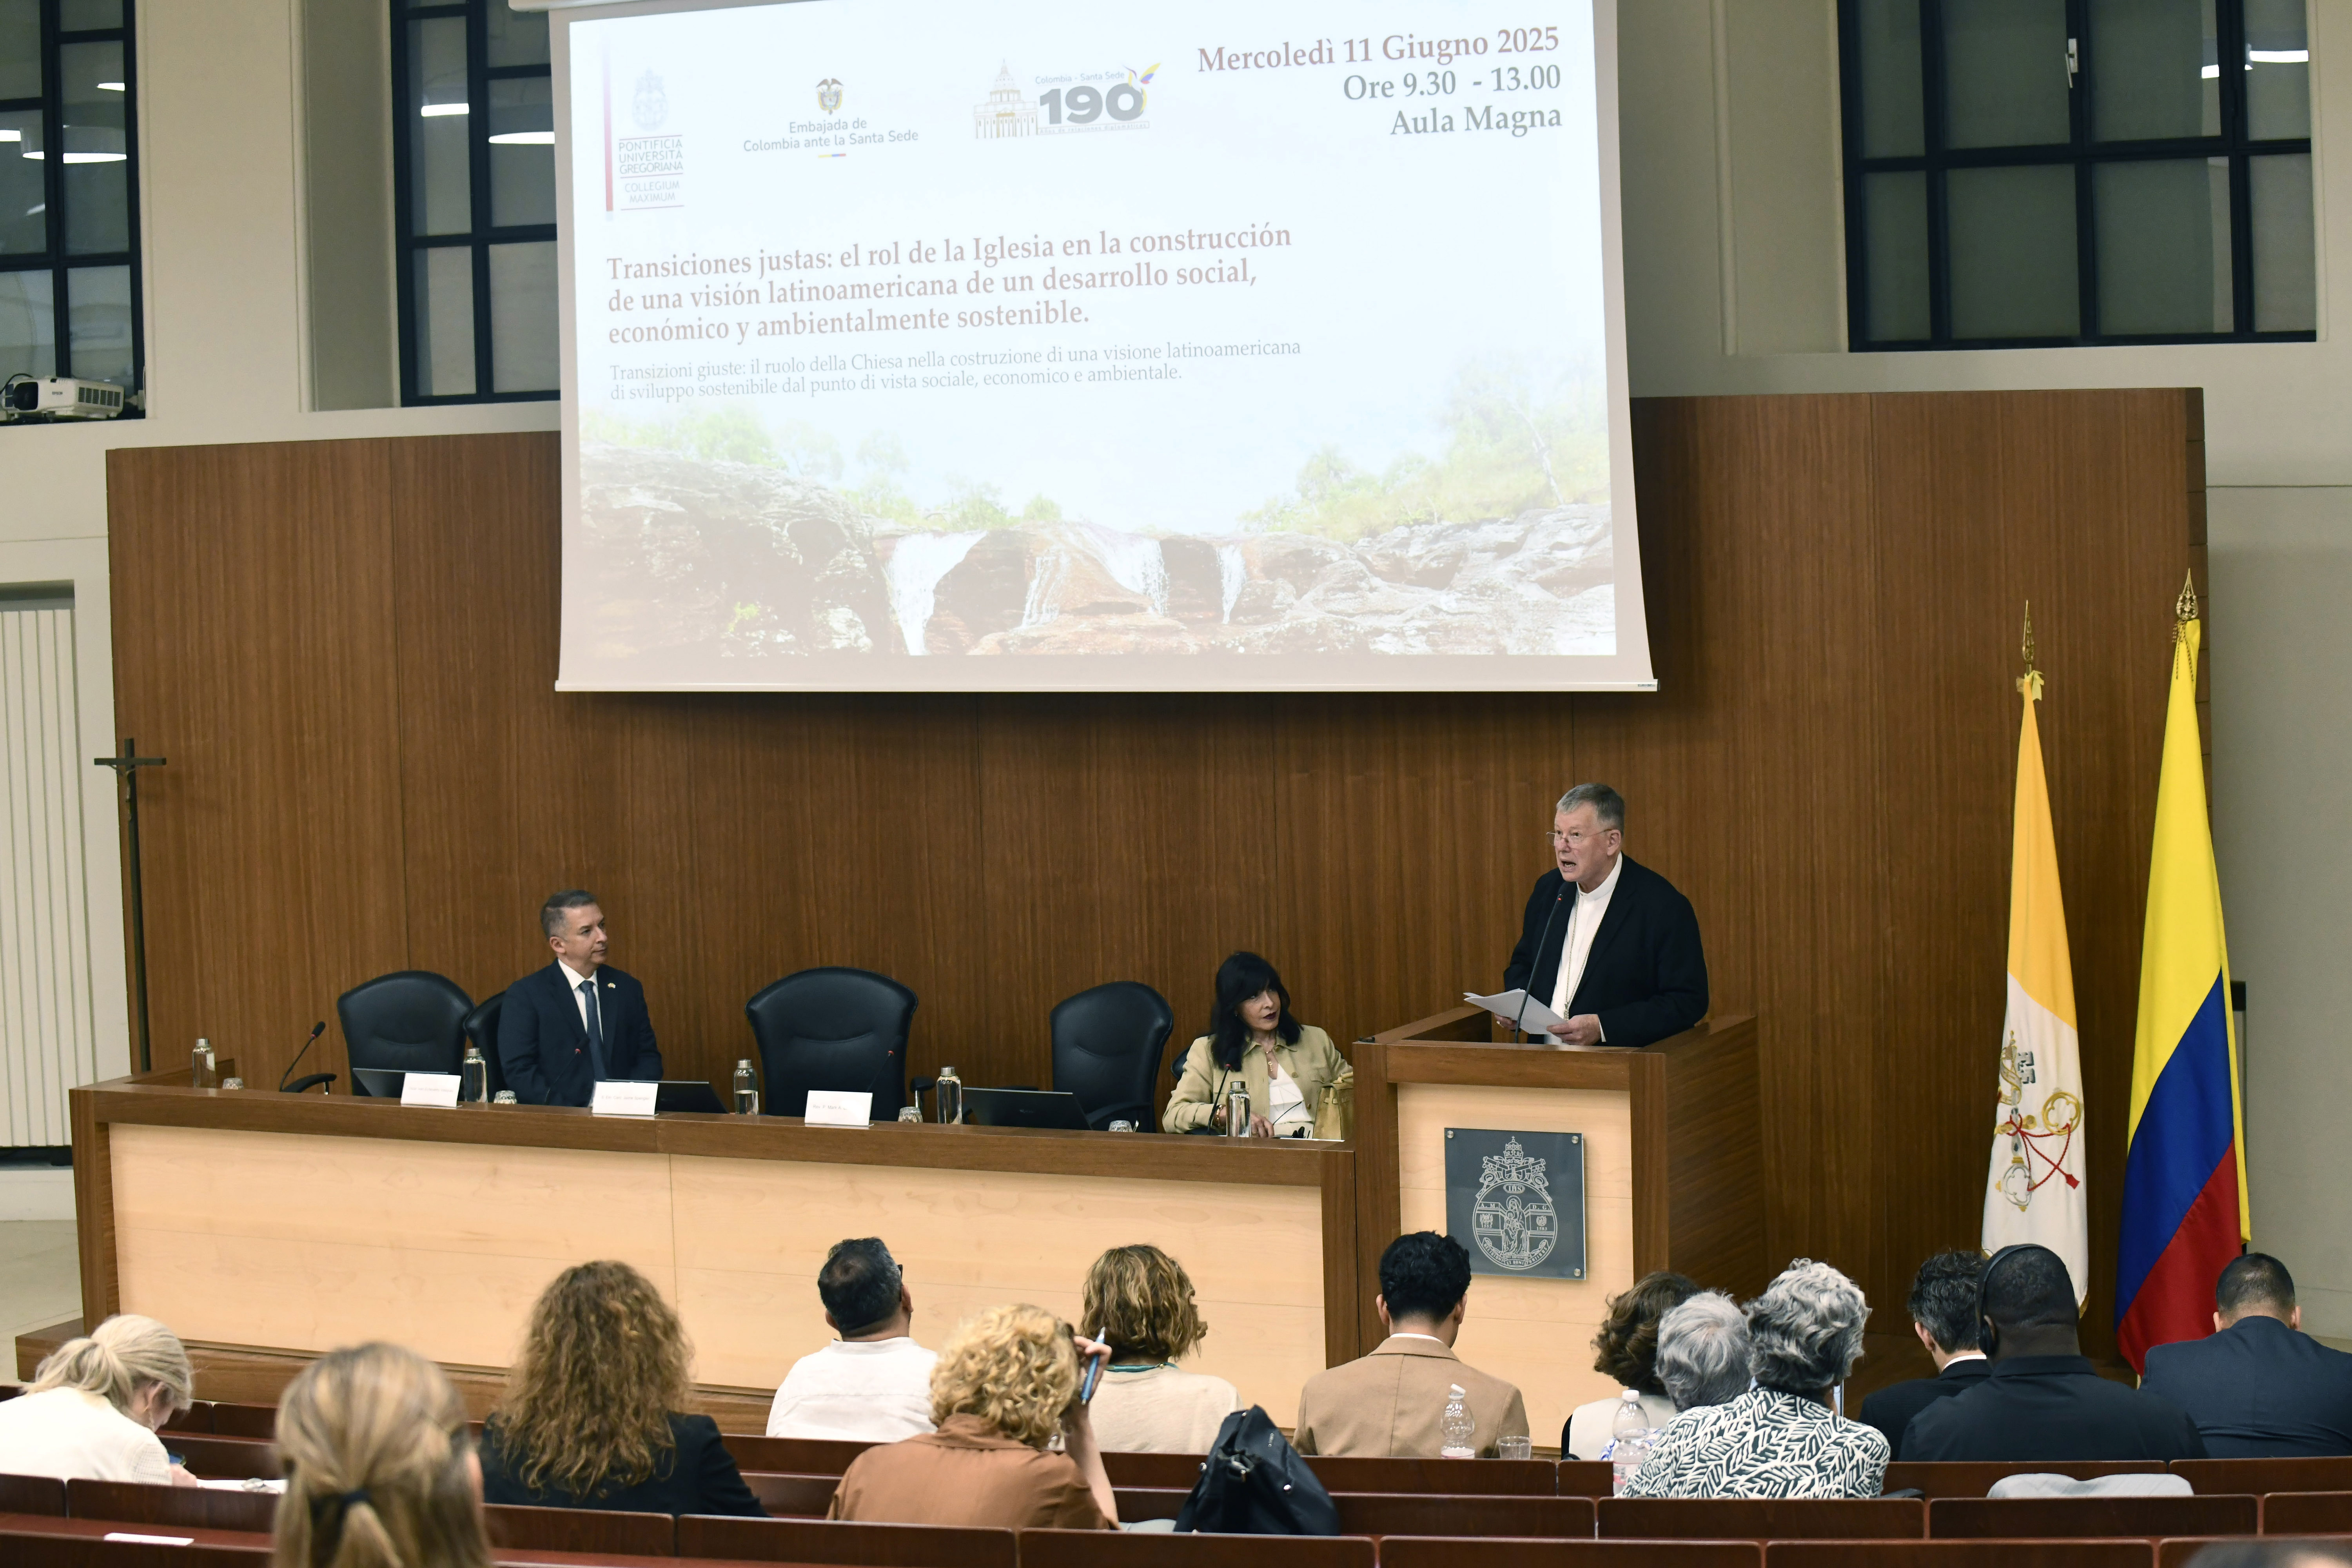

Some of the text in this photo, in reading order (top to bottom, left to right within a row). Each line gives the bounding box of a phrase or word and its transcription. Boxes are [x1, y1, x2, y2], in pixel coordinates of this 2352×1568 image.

[1198, 27, 1558, 72] Mercoledì 11 Giugno 2025
[1036, 75, 1072, 84] Colombia
[1344, 75, 1394, 100] Ore
[1404, 71, 1455, 96] 9.30
[1491, 65, 1560, 91] 13.00
[1040, 83, 1144, 125] 190
[790, 118, 867, 134] Embajada de
[1390, 105, 1562, 137] Aula Magna
[619, 139, 682, 152] PONTIFICIA
[619, 149, 683, 163] UNIVERSITÀ
[744, 129, 918, 151] Colombia ante la Santa Sede
[620, 162, 683, 174] GREGORIANA
[625, 180, 679, 192] COLLEGIUM
[630, 192, 675, 203] MAXIMUM
[607, 222, 1291, 279] Transiciones justas: el rol de la Iglesia en la construcción
[609, 258, 1256, 311] de una visión latinoamericana de un desarrollo social,
[610, 299, 1089, 345] económico y ambientalmente sostenible.
[610, 339, 1300, 381] Transizioni giuste: il ruolo della Chiesa nella costruzione di una visione latinoamericana
[611, 363, 1181, 403] di sviluppo sostenibile dal punto di vista sociale, economico e ambientale.
